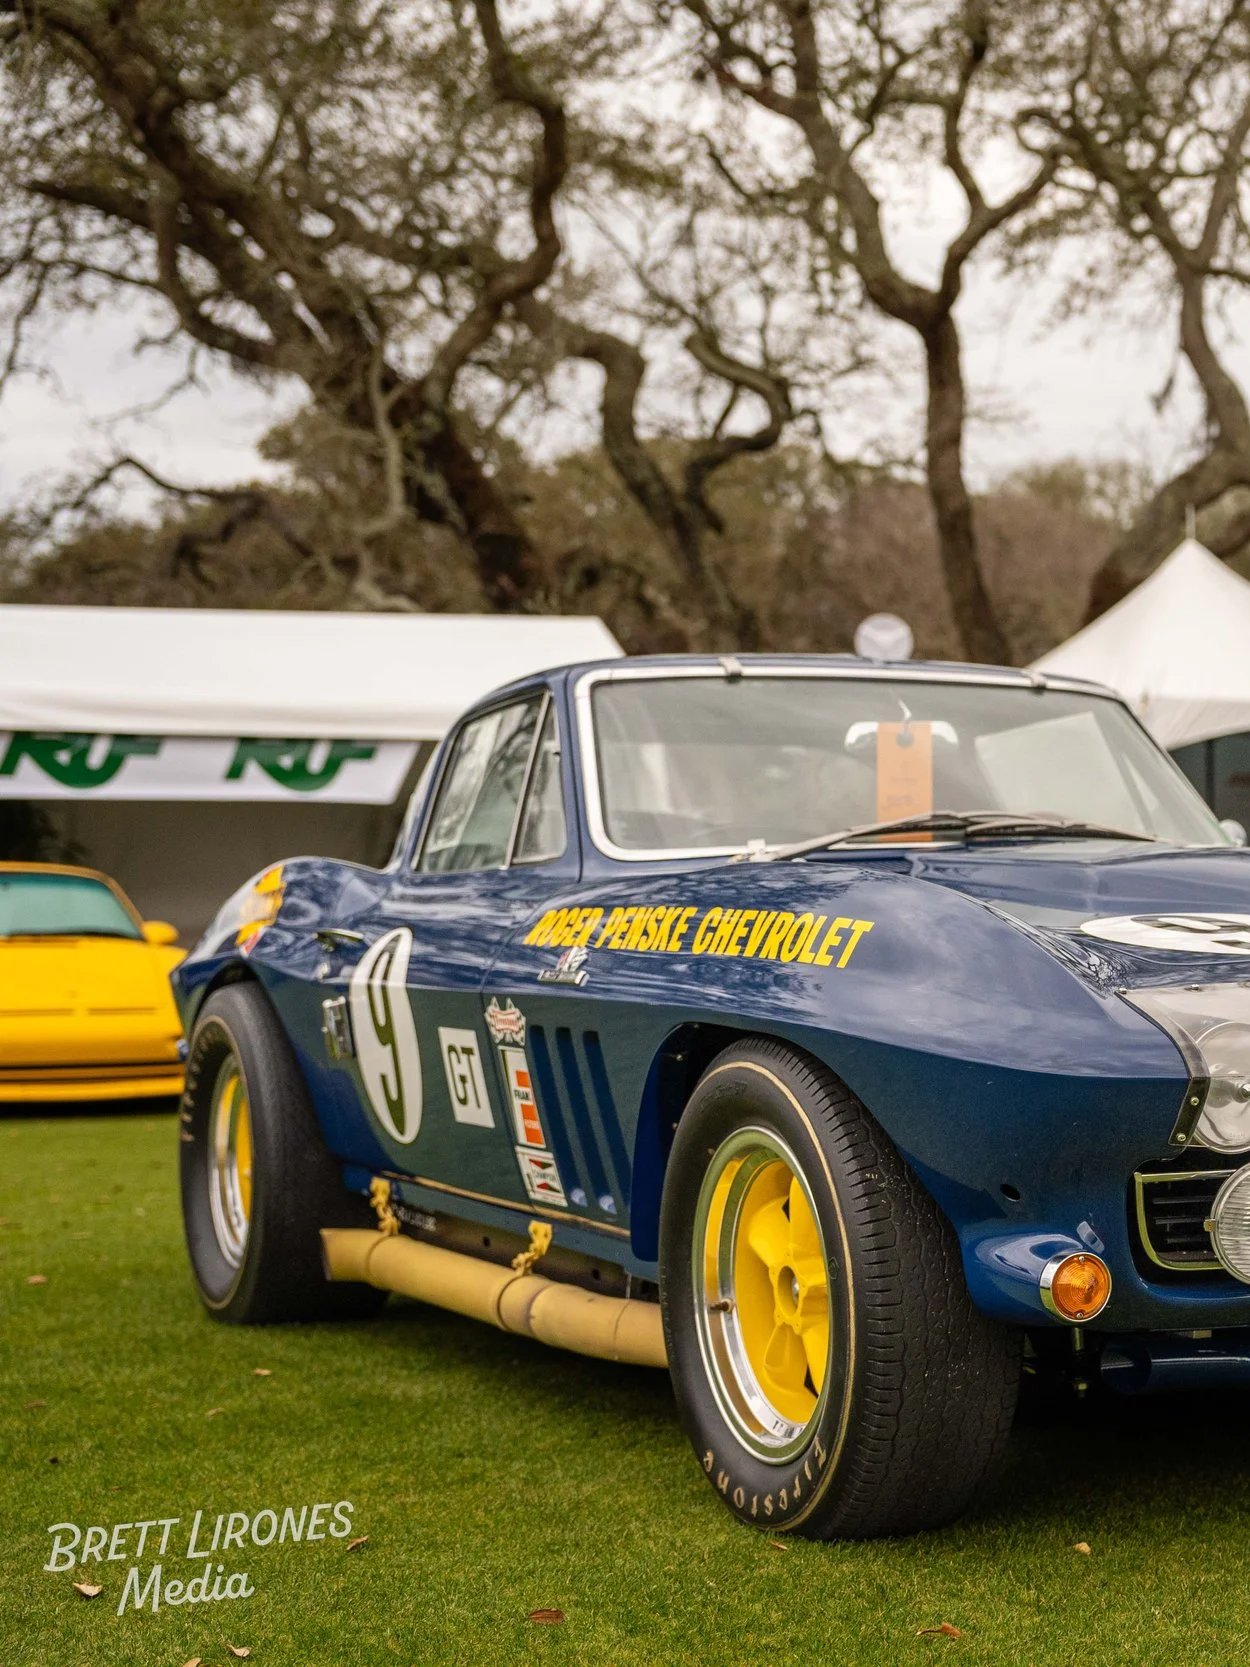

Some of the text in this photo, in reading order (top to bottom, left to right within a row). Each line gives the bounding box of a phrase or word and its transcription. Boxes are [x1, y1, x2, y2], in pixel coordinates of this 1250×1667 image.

[523, 905, 875, 969] ROGER PENSKE CHEVROLET
[367, 933, 407, 1136] 9
[448, 1044, 481, 1109] GT
